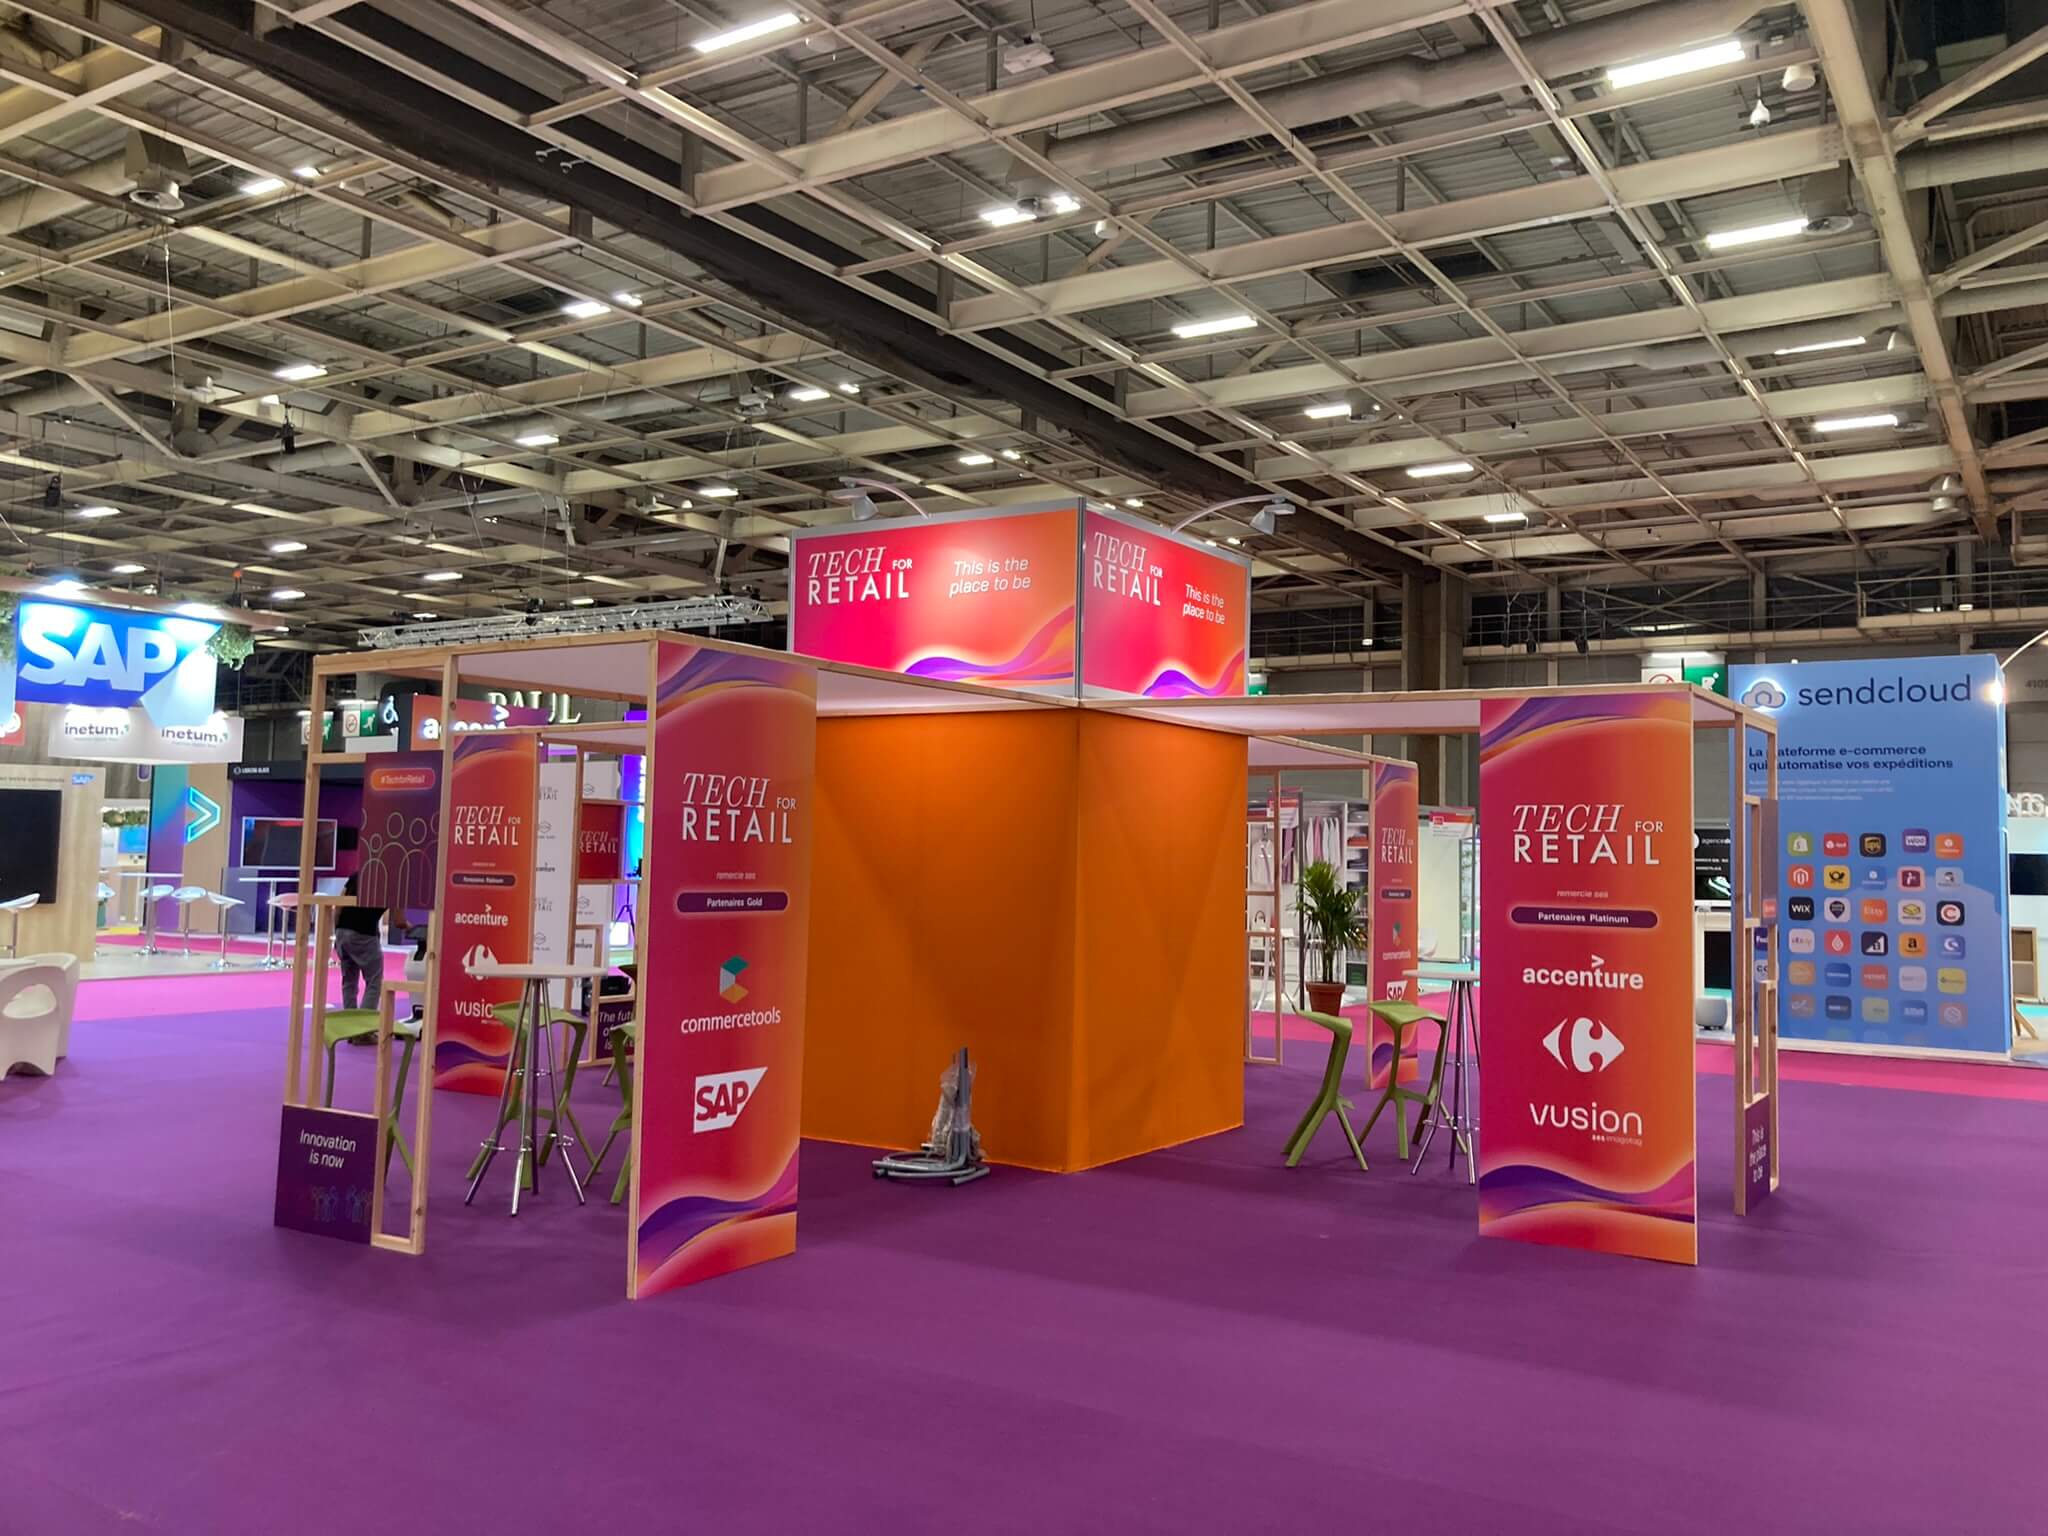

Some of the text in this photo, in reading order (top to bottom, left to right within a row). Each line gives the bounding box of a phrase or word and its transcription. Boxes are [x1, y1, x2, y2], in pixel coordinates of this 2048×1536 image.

[808, 546, 912, 578] TECH FOR
[954, 557, 1029, 576] This is the
[1093, 532, 1163, 578] TECH FOR
[808, 571, 909, 606] RETAIL
[949, 574, 1031, 598] place to be
[1093, 559, 1161, 606] RETAIL
[1185, 583, 1224, 609] This is the
[1183, 603, 1225, 625] place to be
[19, 617, 178, 692] SAP
[1798, 674, 1971, 706] sendcloud
[1749, 745, 1926, 760] La ateforme e-commerce
[1749, 758, 1953, 773] qui utomatise vos expéditions
[683, 773, 797, 809] TECH FOR
[456, 806, 521, 825] TECH FOR
[682, 807, 792, 843] RETAIL
[1513, 804, 1664, 833] TECH FOR
[454, 825, 519, 846] RETAIL
[1382, 827, 1406, 846] TECH
[1382, 845, 1413, 864] RETAIL
[1514, 833, 1660, 865] RETAIL
[706, 897, 763, 908] Partenaires Gold
[455, 910, 509, 927] accenture
[1538, 911, 1629, 924] Partenaires Platinum
[1522, 966, 1644, 989] accenture
[681, 1006, 782, 1034] commercetools
[695, 1080, 749, 1121] SAP
[1529, 1102, 1643, 1136] vusion
[300, 1128, 357, 1152] Innovation
[309, 1148, 345, 1169] is now
